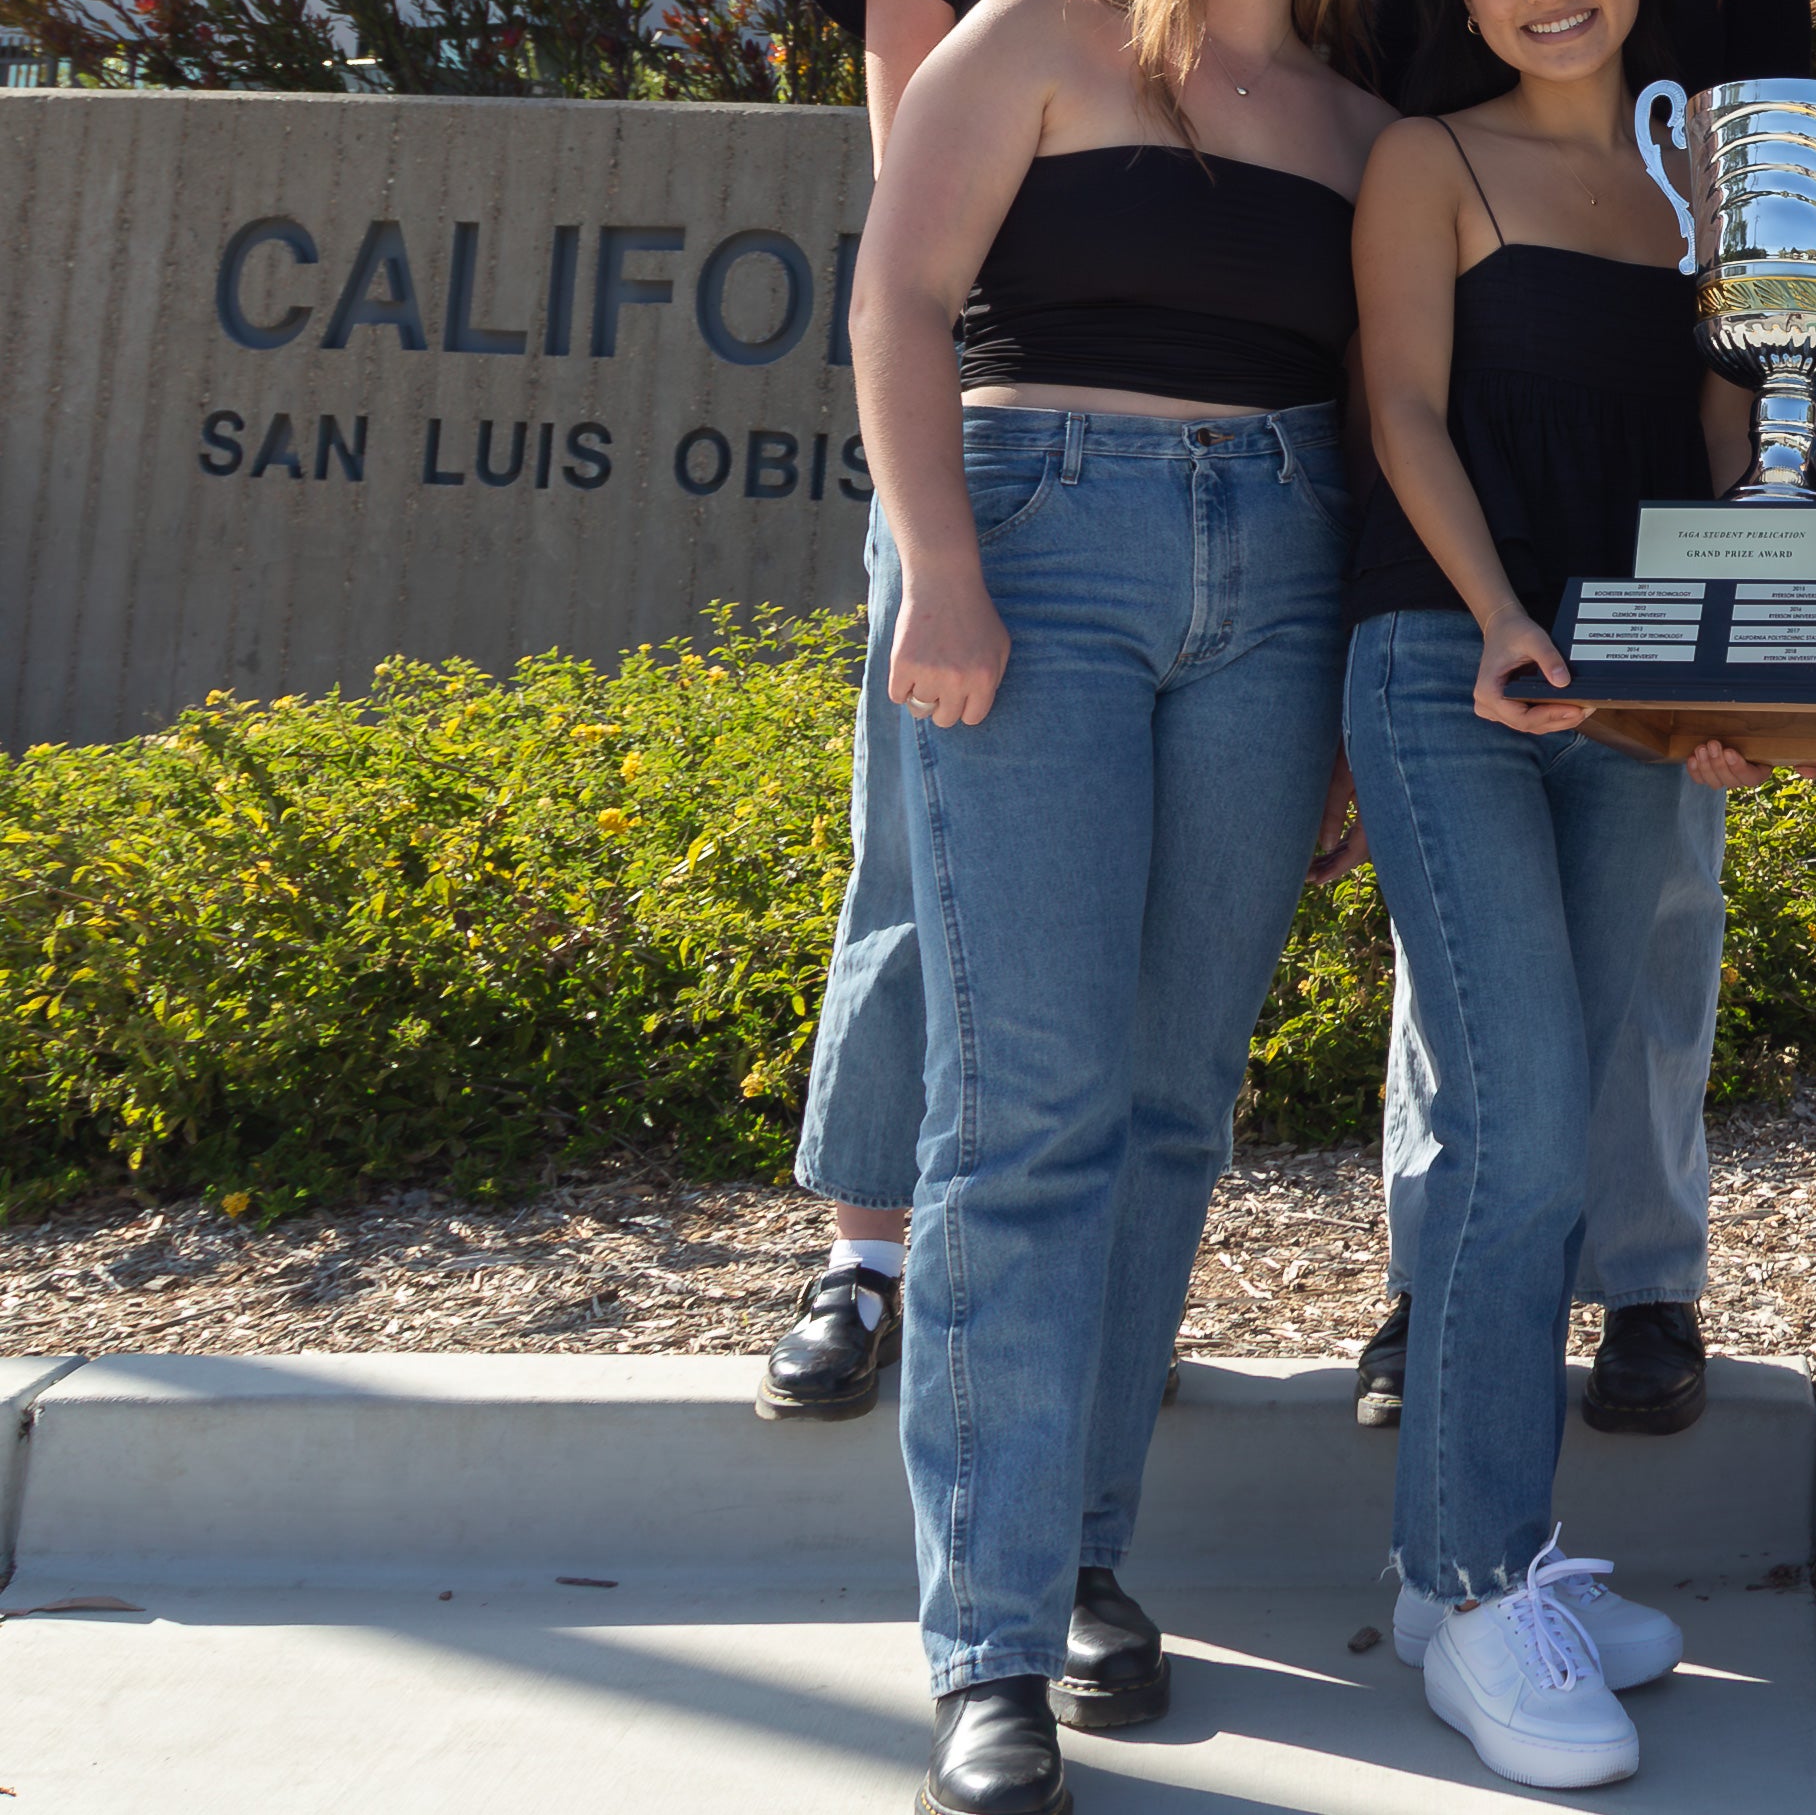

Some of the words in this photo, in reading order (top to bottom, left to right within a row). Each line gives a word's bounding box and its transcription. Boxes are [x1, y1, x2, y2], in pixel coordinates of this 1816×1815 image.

[214, 215, 862, 366] CALIFO
[200, 410, 369, 482] SAN
[422, 418, 613, 491] LUIS
[674, 427, 874, 502] OBIS
[1678, 531, 1700, 539] TAGA
[1702, 531, 1744, 539] STUDENT
[1746, 531, 1806, 539] PUBLICATION
[1687, 550, 1721, 558] GRAND
[1724, 550, 1754, 558] PRIZE
[1758, 550, 1793, 558] AWARD
